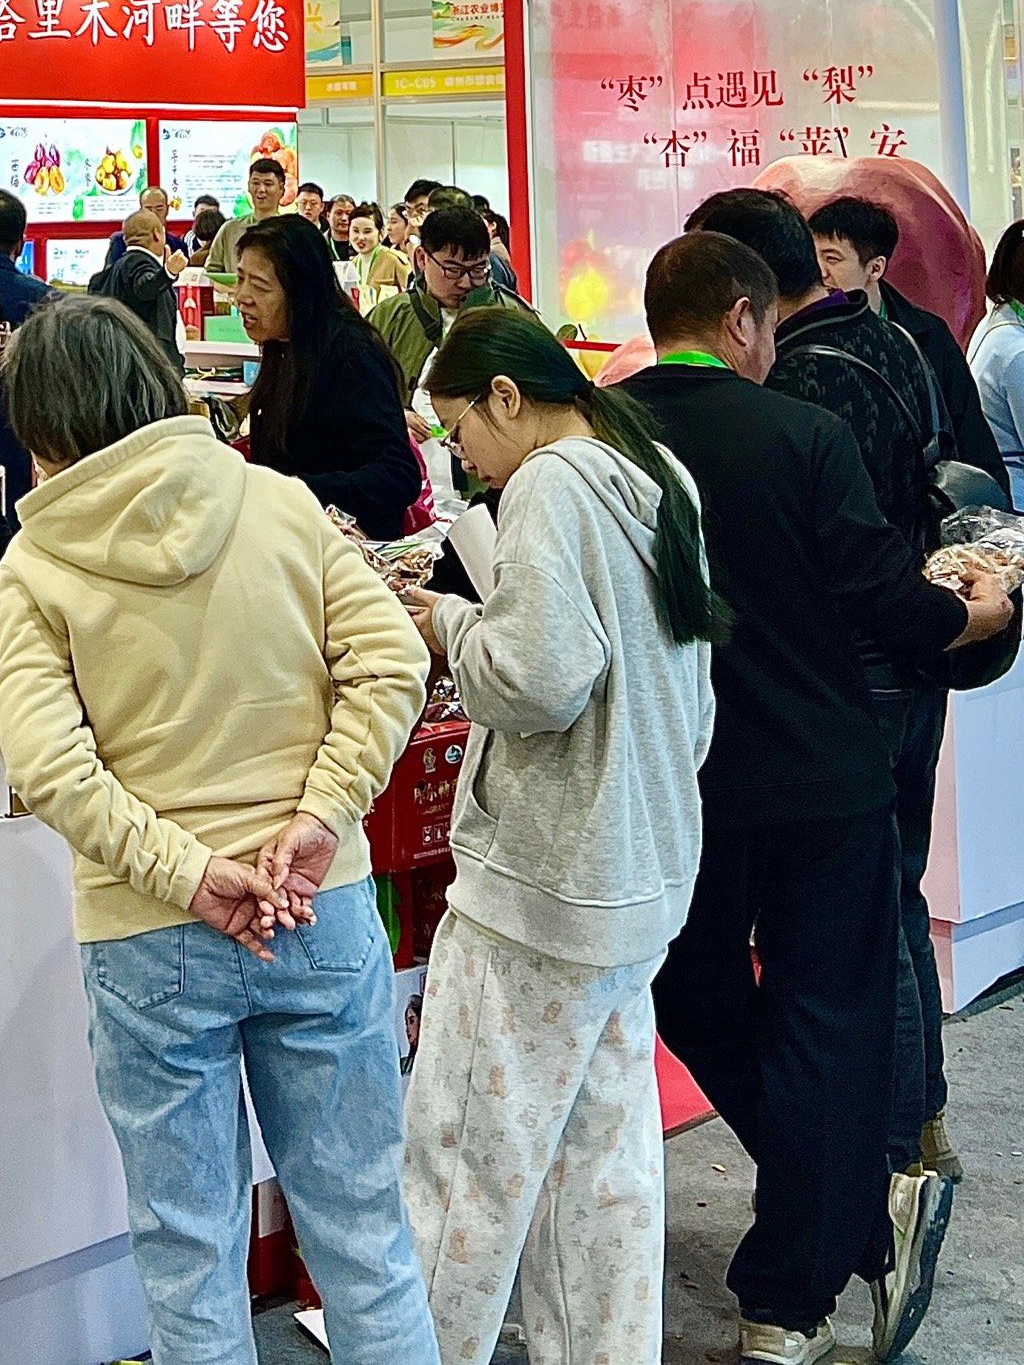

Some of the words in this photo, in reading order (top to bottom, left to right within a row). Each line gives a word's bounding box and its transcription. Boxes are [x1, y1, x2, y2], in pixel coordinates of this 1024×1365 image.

[682, 70, 784, 111] 点遇见
[726, 128, 761, 167] 福
[870, 124, 908, 158] 安
